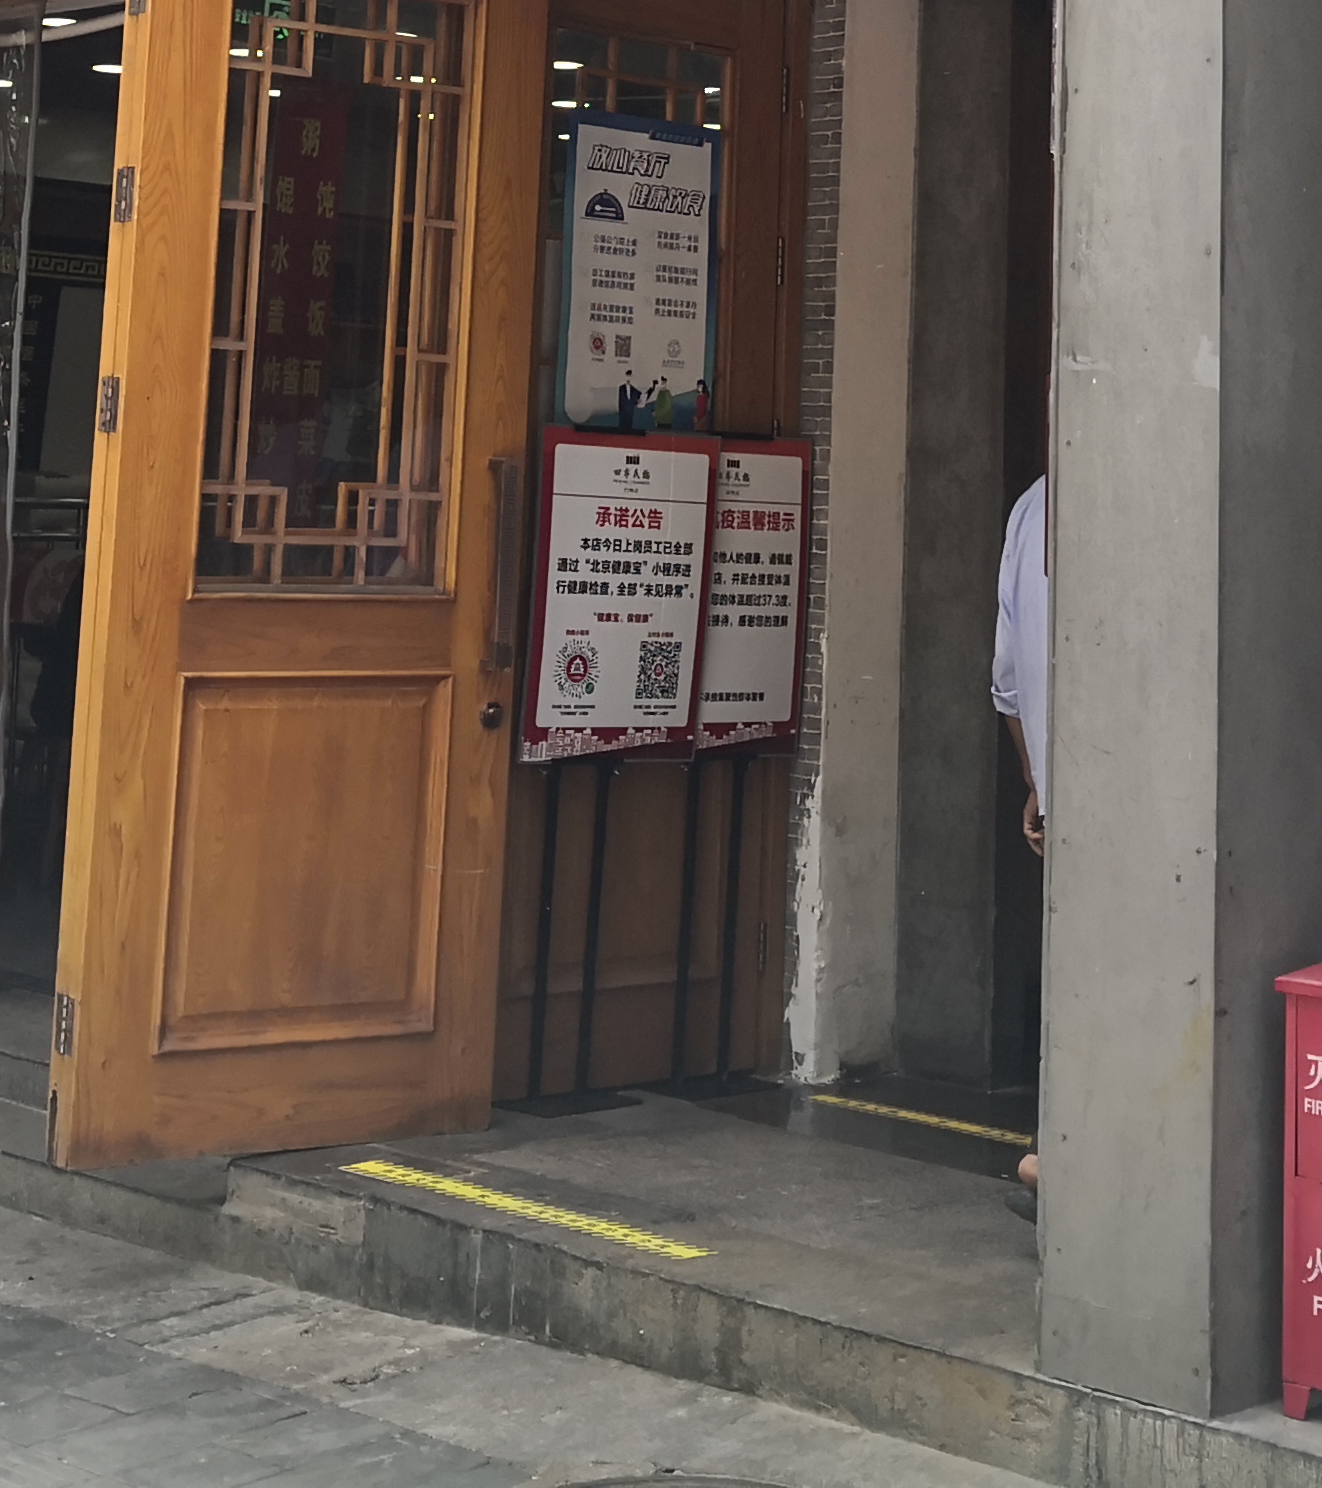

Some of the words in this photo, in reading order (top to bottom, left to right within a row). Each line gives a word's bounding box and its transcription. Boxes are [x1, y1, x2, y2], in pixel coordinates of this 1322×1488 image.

[301, 117, 322, 158] 粥
[587, 144, 670, 179] 放心餐厅
[628, 182, 706, 216] 健康饮食
[271, 235, 333, 279] 水饺
[267, 297, 326, 338] 盖饭
[262, 357, 322, 398] 炸酱面
[257, 418, 317, 457] 炒菜
[595, 505, 663, 530] 承诺公告
[580, 537, 694, 556] 本店今日上岗员工已全部
